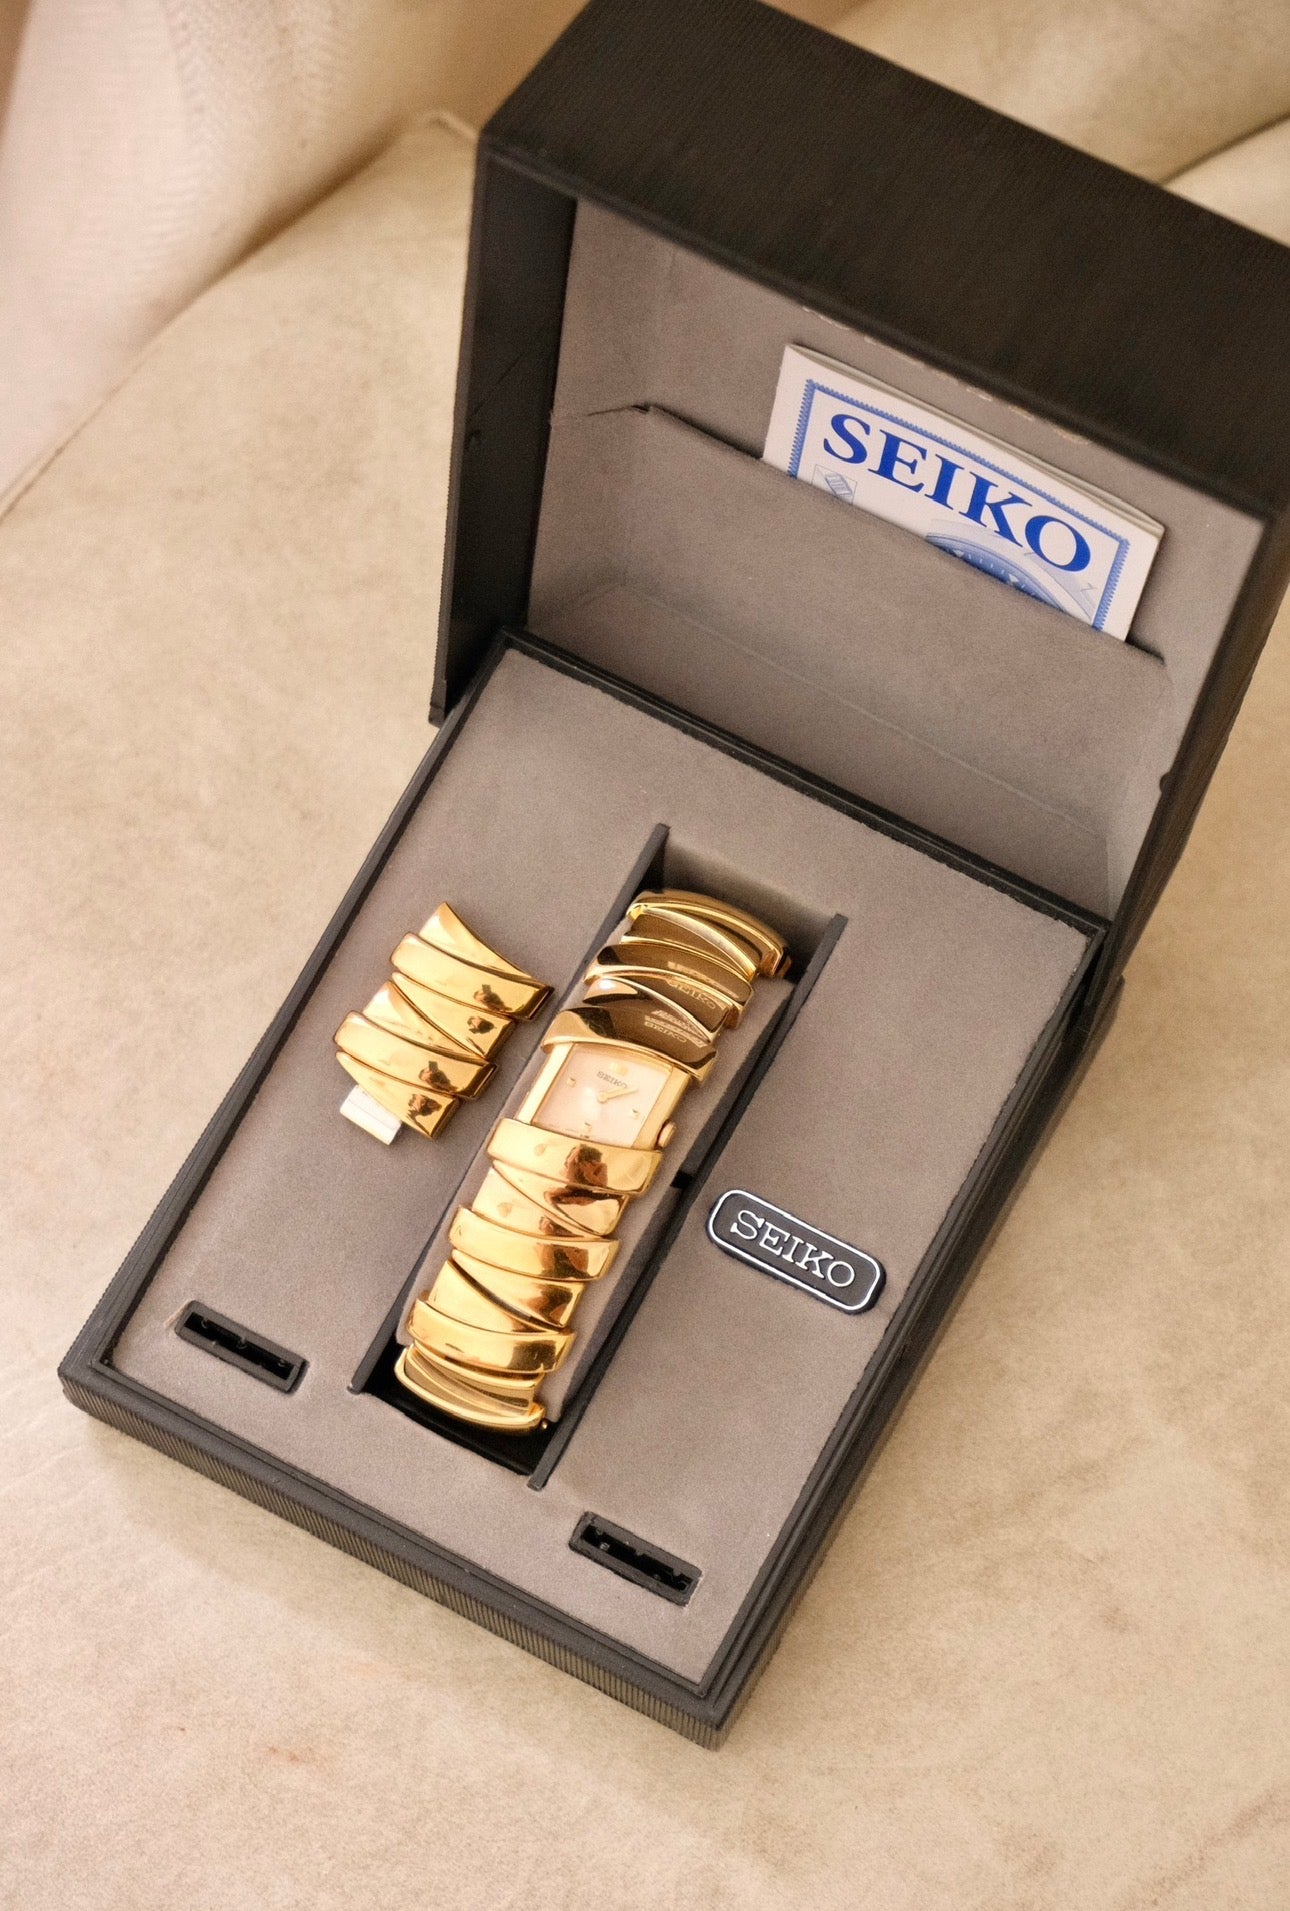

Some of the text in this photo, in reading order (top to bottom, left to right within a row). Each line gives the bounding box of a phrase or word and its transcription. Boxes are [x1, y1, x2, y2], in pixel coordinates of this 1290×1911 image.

[823, 413, 1092, 572] SEIKO
[596, 1071, 628, 1089] SEIKO
[730, 1209, 855, 1288] SEIKO
